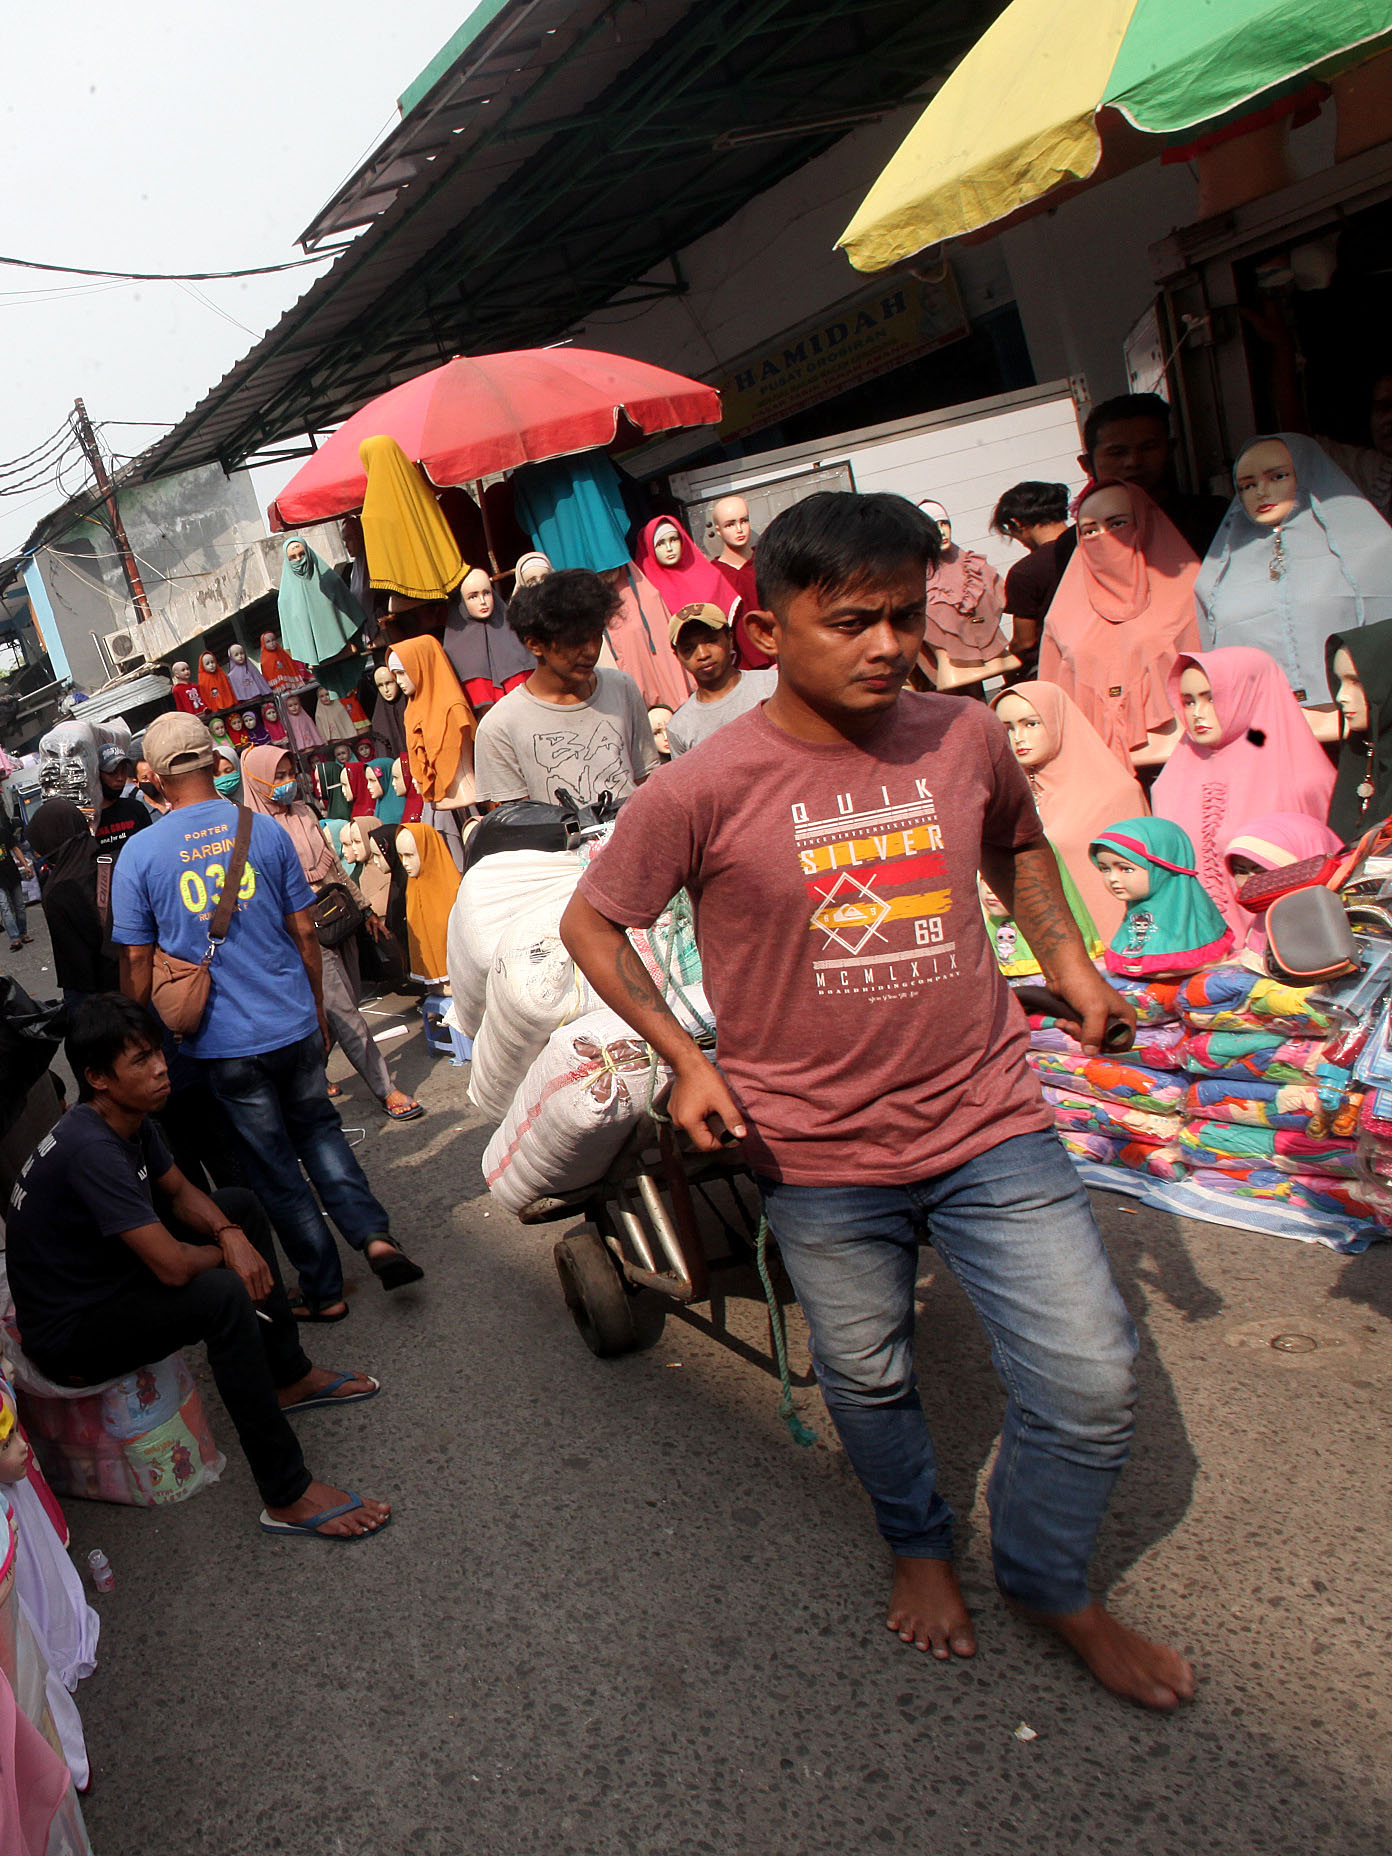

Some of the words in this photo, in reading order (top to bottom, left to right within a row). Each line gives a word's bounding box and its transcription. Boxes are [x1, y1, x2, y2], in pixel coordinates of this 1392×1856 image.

[735, 290, 907, 392] HAMIDAH
[791, 778, 933, 824] QUIK
[184, 824, 228, 842] PORTER
[800, 824, 945, 875] SILVER
[914, 917, 943, 945] 69
[816, 954, 958, 988] MCMLXIX
